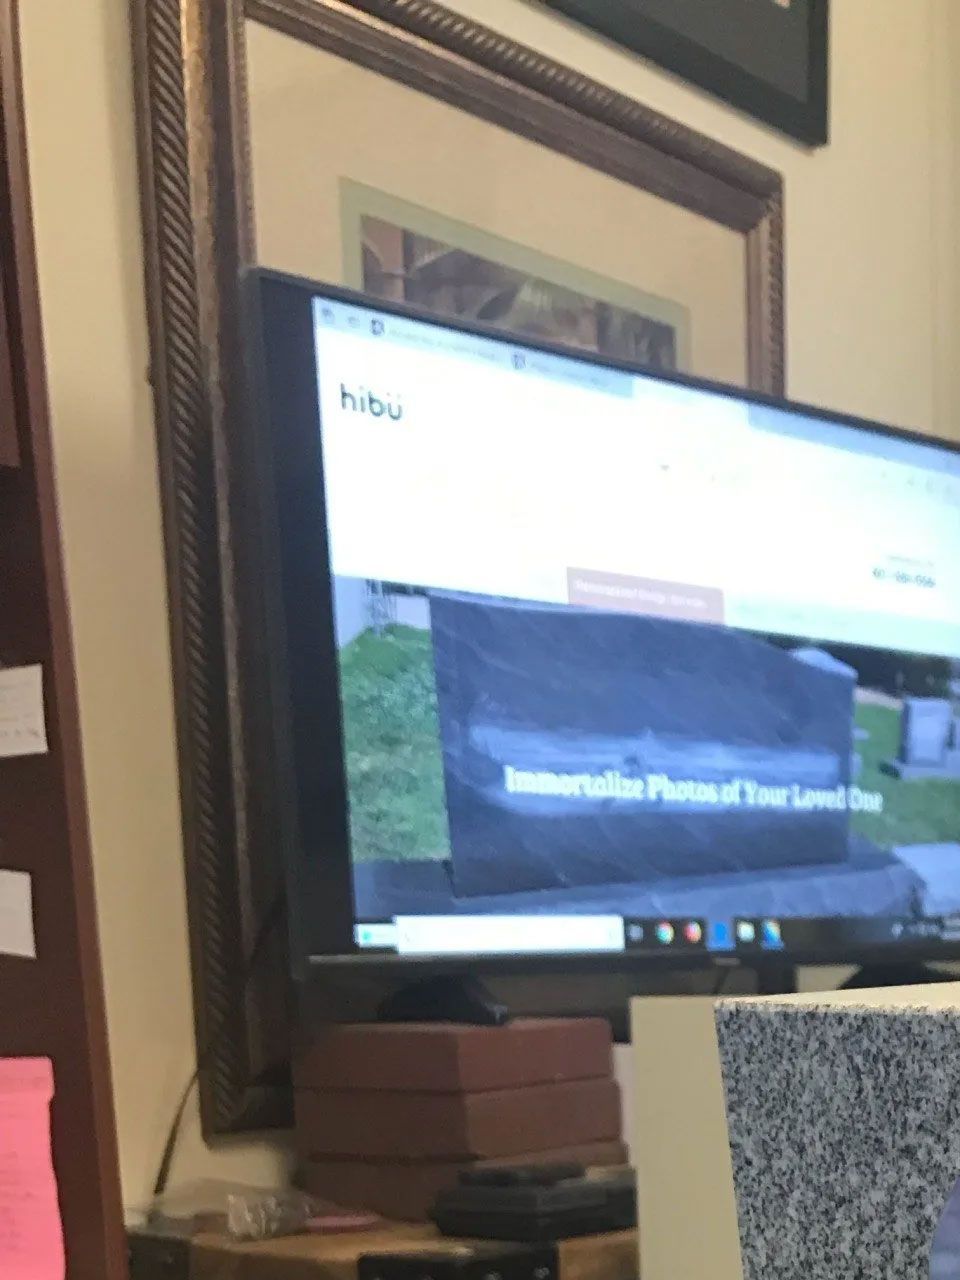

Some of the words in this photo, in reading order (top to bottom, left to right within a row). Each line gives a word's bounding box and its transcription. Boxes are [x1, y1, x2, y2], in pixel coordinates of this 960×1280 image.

[504, 765, 645, 799] Immortalize
[648, 773, 718, 803] Photos
[720, 777, 742, 803] of
[744, 778, 788, 806] Your
[793, 783, 846, 809] Loved
[848, 785, 884, 812] One
